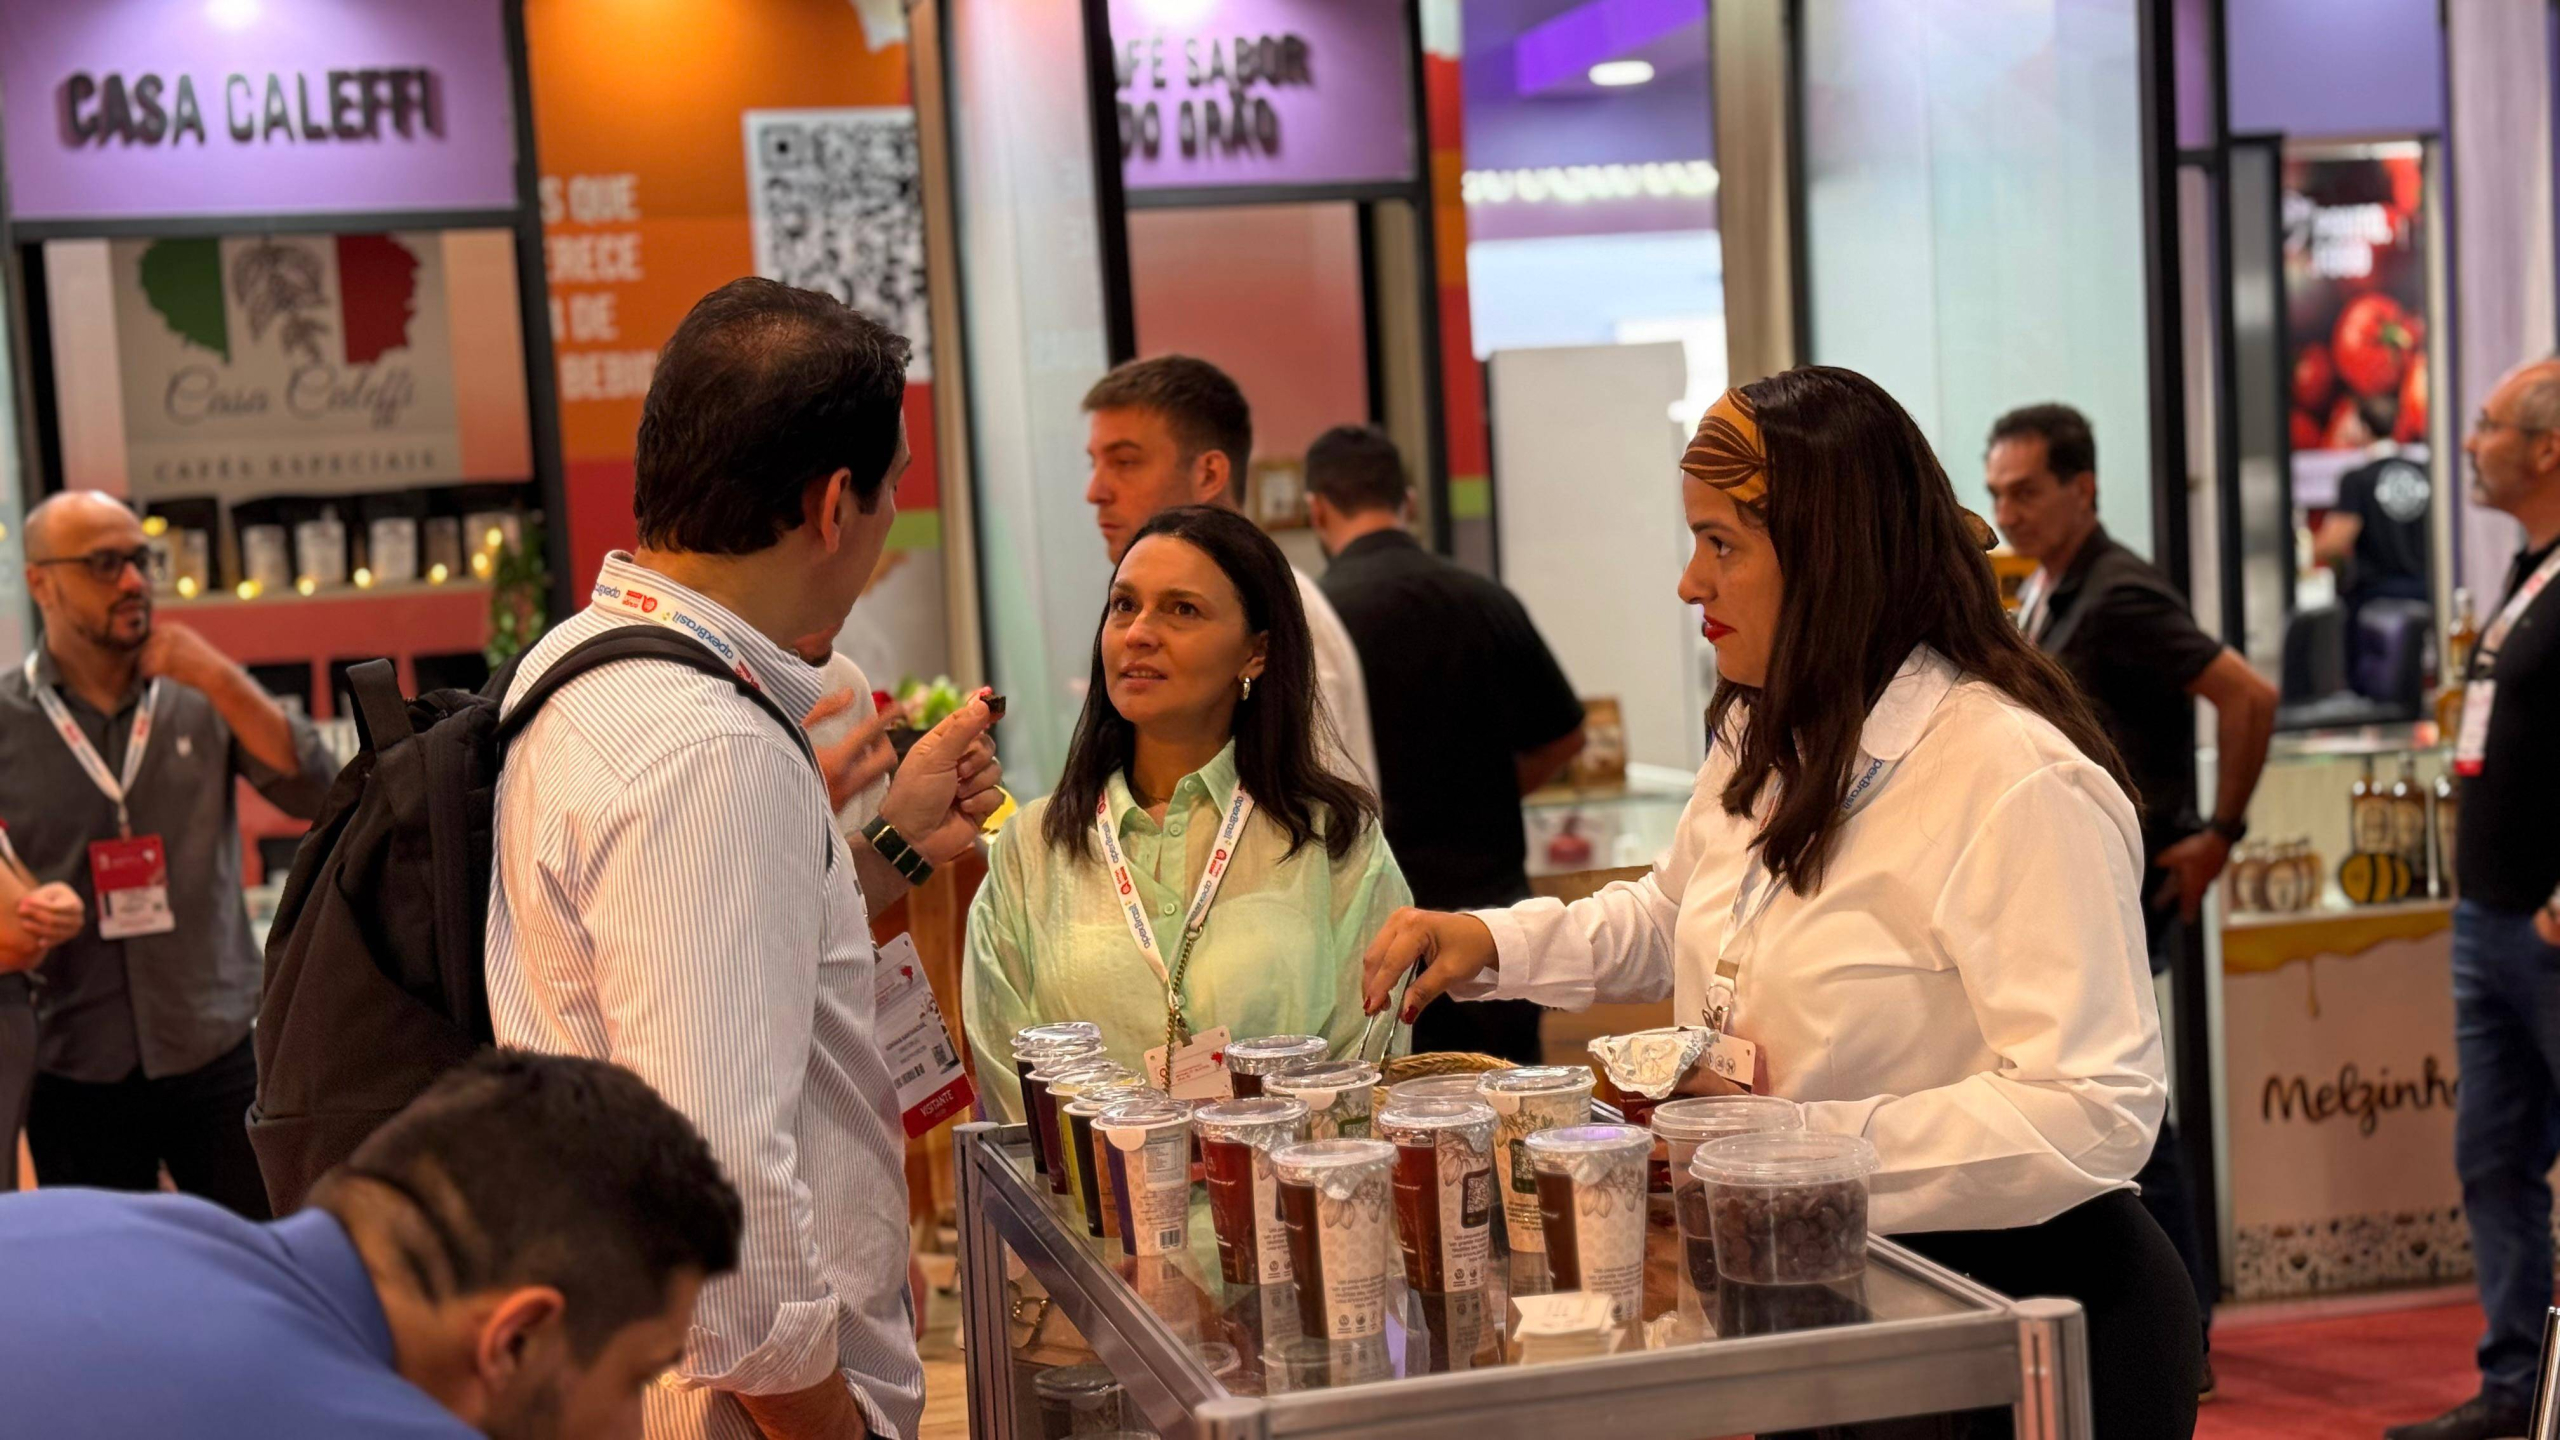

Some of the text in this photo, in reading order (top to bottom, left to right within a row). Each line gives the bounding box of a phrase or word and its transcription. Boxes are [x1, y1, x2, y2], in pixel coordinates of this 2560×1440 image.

[1184, 33, 1313, 88] SABOR
[62, 67, 440, 148] CASA CALEFFI
[567, 174, 641, 226] QUE
[164, 361, 415, 431] Casa Caleffi
[673, 611, 734, 659] apexBrasil
[1223, 796, 1244, 840] apexBrasil
[1128, 903, 1151, 950] apexBrasil
[920, 1089, 954, 1117] VISITANTE
